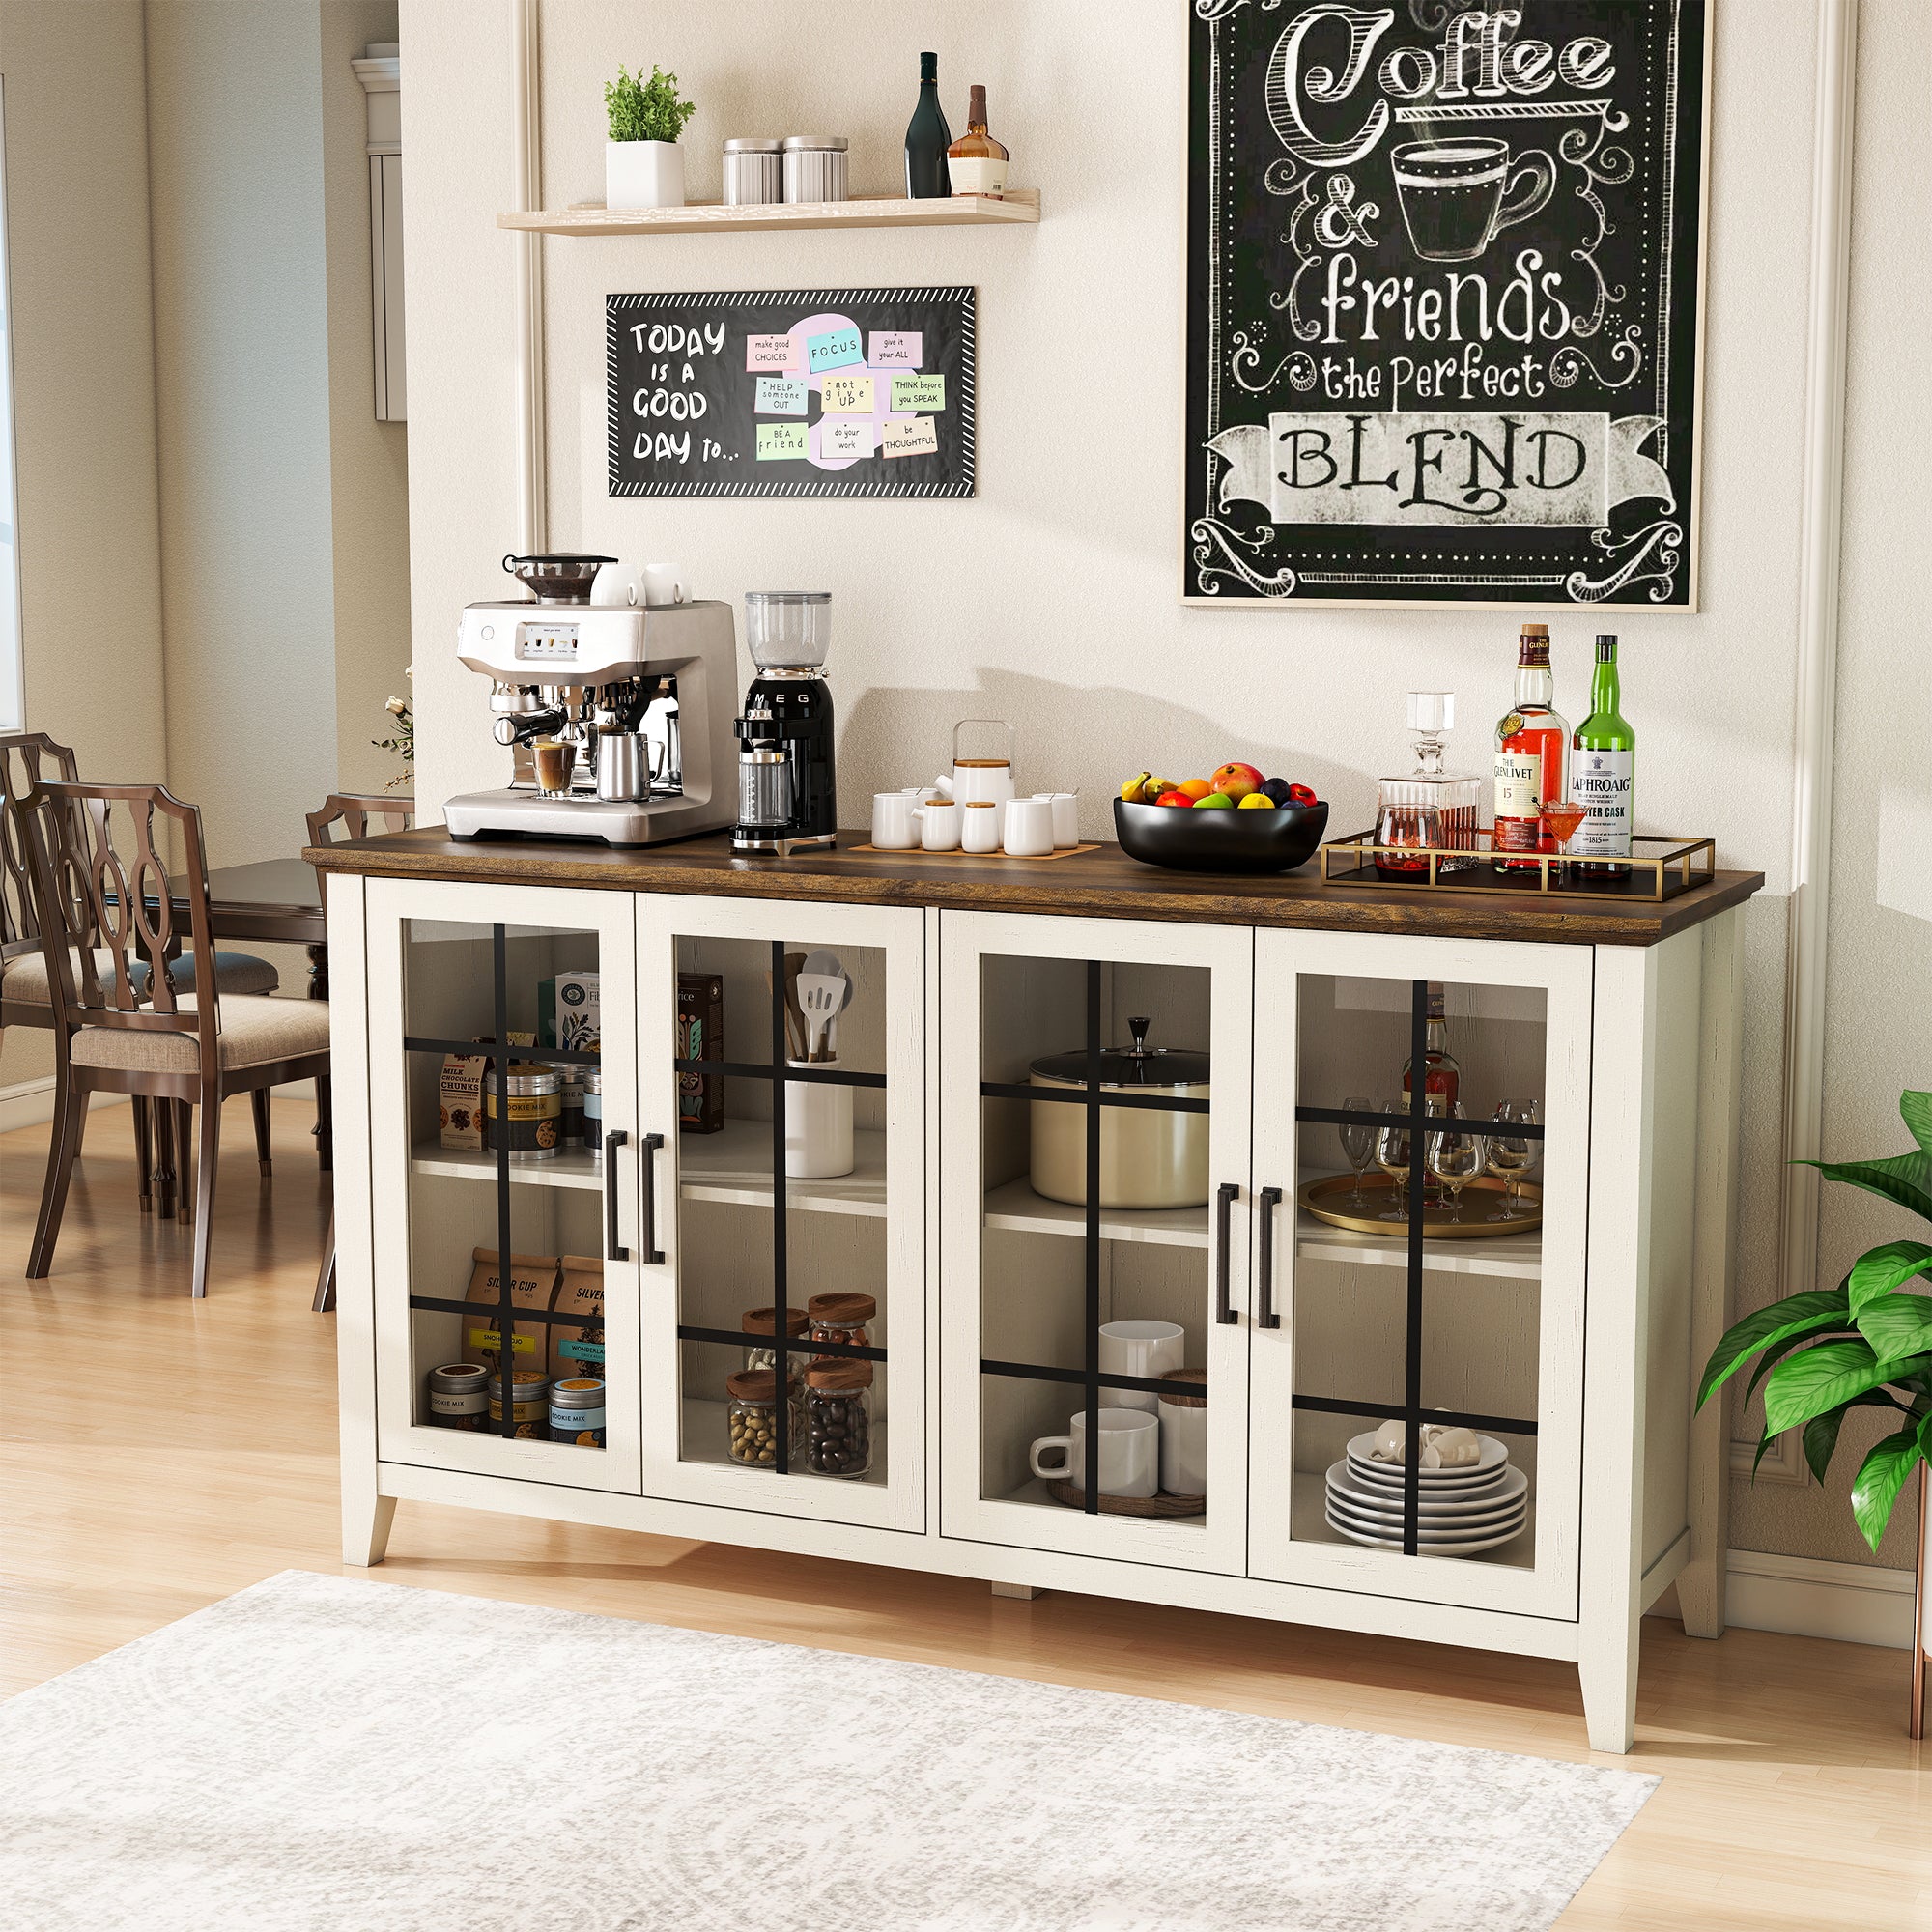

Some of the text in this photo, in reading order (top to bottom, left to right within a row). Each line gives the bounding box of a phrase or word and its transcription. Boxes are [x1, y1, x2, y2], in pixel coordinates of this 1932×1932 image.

[1265, 5, 1616, 167] Coffee
[1314, 173, 1379, 248] &
[1320, 248, 1571, 344] friends
[629, 322, 725, 358] TODAY
[755, 339, 789, 351] make good
[883, 339, 896, 348] give
[811, 340, 857, 359] FOCUS
[754, 353, 788, 362] CHOICES
[878, 352, 894, 361] your
[650, 362, 695, 384] IS A
[1321, 355, 1381, 400] the
[769, 383, 793, 391] HELP
[835, 380, 855, 389] not
[895, 381, 943, 391] THINK before
[632, 387, 708, 421] GOOD
[773, 400, 789, 410] OUT
[839, 396, 856, 407] UP
[898, 394, 938, 406] you SPEAK
[774, 430, 783, 439] BE
[834, 427, 860, 439] do your
[904, 425, 913, 434] be
[633, 431, 691, 465] DAY
[758, 437, 804, 453] friend
[838, 440, 856, 449] work
[885, 436, 936, 450] THOUGHTFUL
[1277, 414, 1588, 515] BLEND
[1502, 758, 1515, 767] THE
[1493, 765, 1533, 781] GLENLIVET
[1572, 776, 1631, 792] LAPHROAIG
[1503, 787, 1512, 799] 15
[1605, 806, 1625, 818] CASK
[1589, 836, 1603, 844] 1815
[442, 1067, 464, 1076] MILK
[441, 1074, 480, 1083] CHOCOLATE
[440, 1081, 479, 1092] CHUNKS
[486, 1277, 537, 1293] SILR CUP
[552, 1412, 572, 1421] COOKIE
